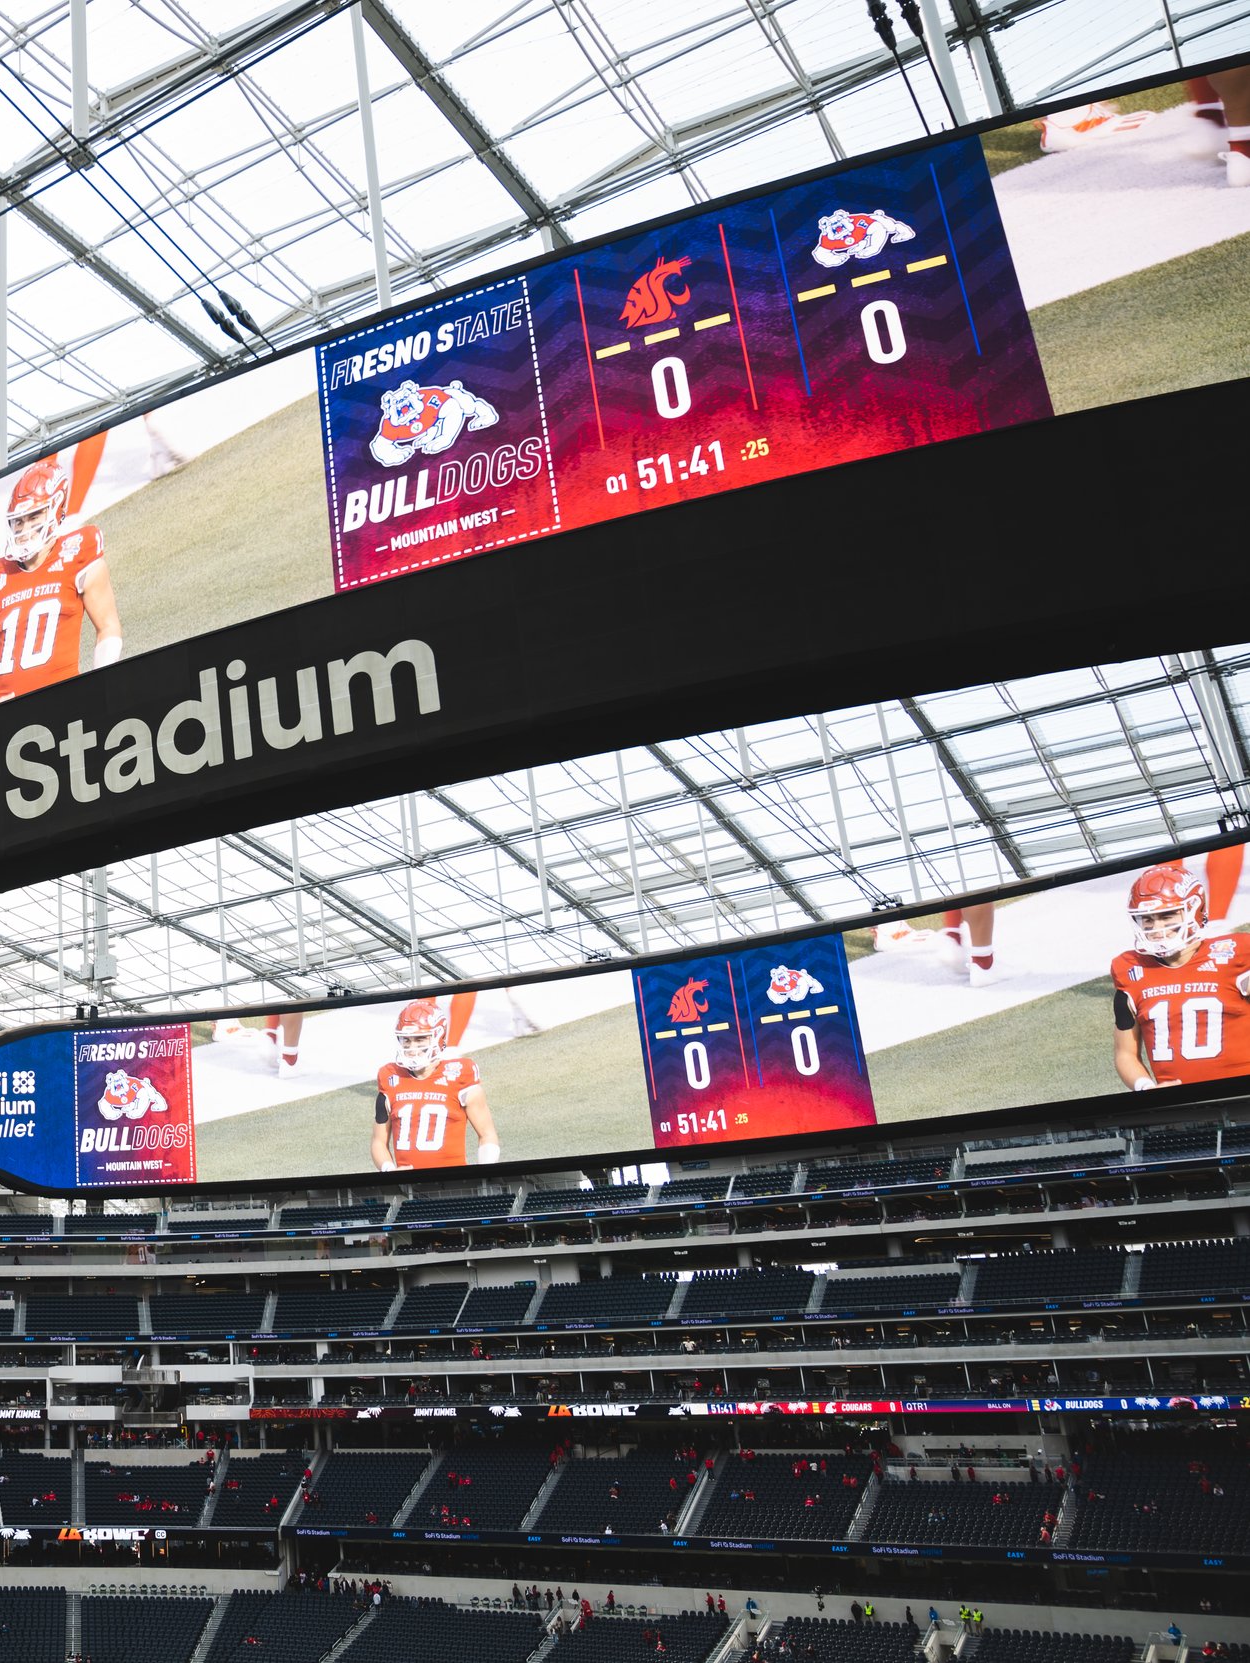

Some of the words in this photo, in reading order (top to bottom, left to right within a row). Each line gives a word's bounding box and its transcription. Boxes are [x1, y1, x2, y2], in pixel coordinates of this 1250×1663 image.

[330, 330, 431, 391] FRESNO
[436, 299, 524, 353] STATE
[860, 299, 907, 364] 0
[650, 356, 692, 419] 0
[606, 472, 628, 494] Q1
[638, 440, 727, 490] 51:41
[739, 437, 770, 461] :25
[343, 437, 543, 533] BULLDOGS
[391, 519, 458, 550] MOUNTAIN
[460, 507, 499, 532] WEST
[1, 588, 32, 609] FRESNO
[33, 582, 62, 597] STATE
[5, 638, 441, 819] Stadium
[1142, 983, 1181, 1000] FRESNO
[1183, 982, 1219, 994] STATE
[1148, 997, 1224, 1062] 10
[78, 1041, 139, 1063] FRESNO
[138, 1038, 185, 1060] STATE
[790, 1025, 820, 1076] 0
[683, 1041, 711, 1090] 0
[395, 1092, 423, 1102] FRESNO
[423, 1092, 447, 1102] STATE
[396, 1103, 449, 1152] 10
[677, 1108, 727, 1135] 51:41
[734, 1113, 749, 1125] :25
[80, 1123, 188, 1153] BULLDOGS
[105, 1161, 141, 1172] MOUNTAIN
[143, 1159, 163, 1171] WEST
[16, 1409, 41, 1418] KIMMEL
[413, 1408, 433, 1416] JIMMY
[434, 1407, 457, 1416] KIMMEL
[548, 1405, 572, 1417] LA
[571, 1404, 639, 1417] BOWL
[711, 1403, 733, 1414] 51:41
[841, 1402, 872, 1412] COUGARS
[889, 1402, 895, 1412] 0
[906, 1402, 928, 1411] QTR1
[1065, 1400, 1103, 1409] BULLDOGS
[1121, 1399, 1128, 1409] 0
[58, 1528, 82, 1540] LA
[81, 1528, 149, 1540] BOWL
